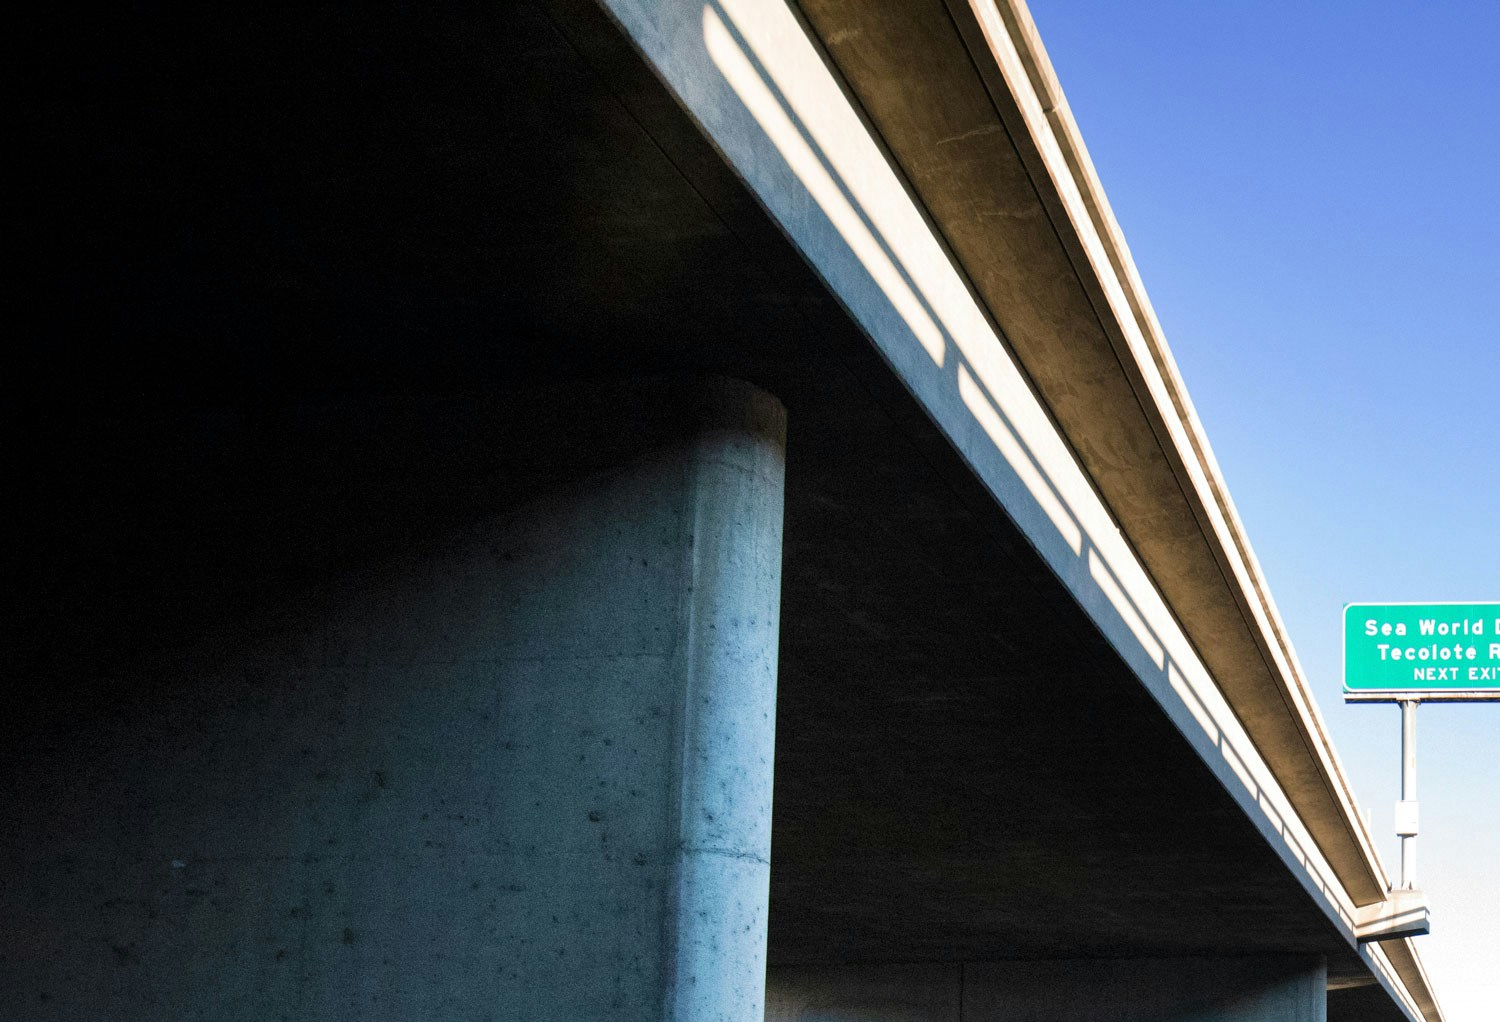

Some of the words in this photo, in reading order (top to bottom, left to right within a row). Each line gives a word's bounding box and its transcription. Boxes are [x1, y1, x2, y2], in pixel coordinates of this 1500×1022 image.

[1364, 619, 1407, 636] Sea
[1418, 618, 1484, 636] World
[1377, 643, 1477, 661] Tecolote
[1413, 667, 1459, 681] NEXT
